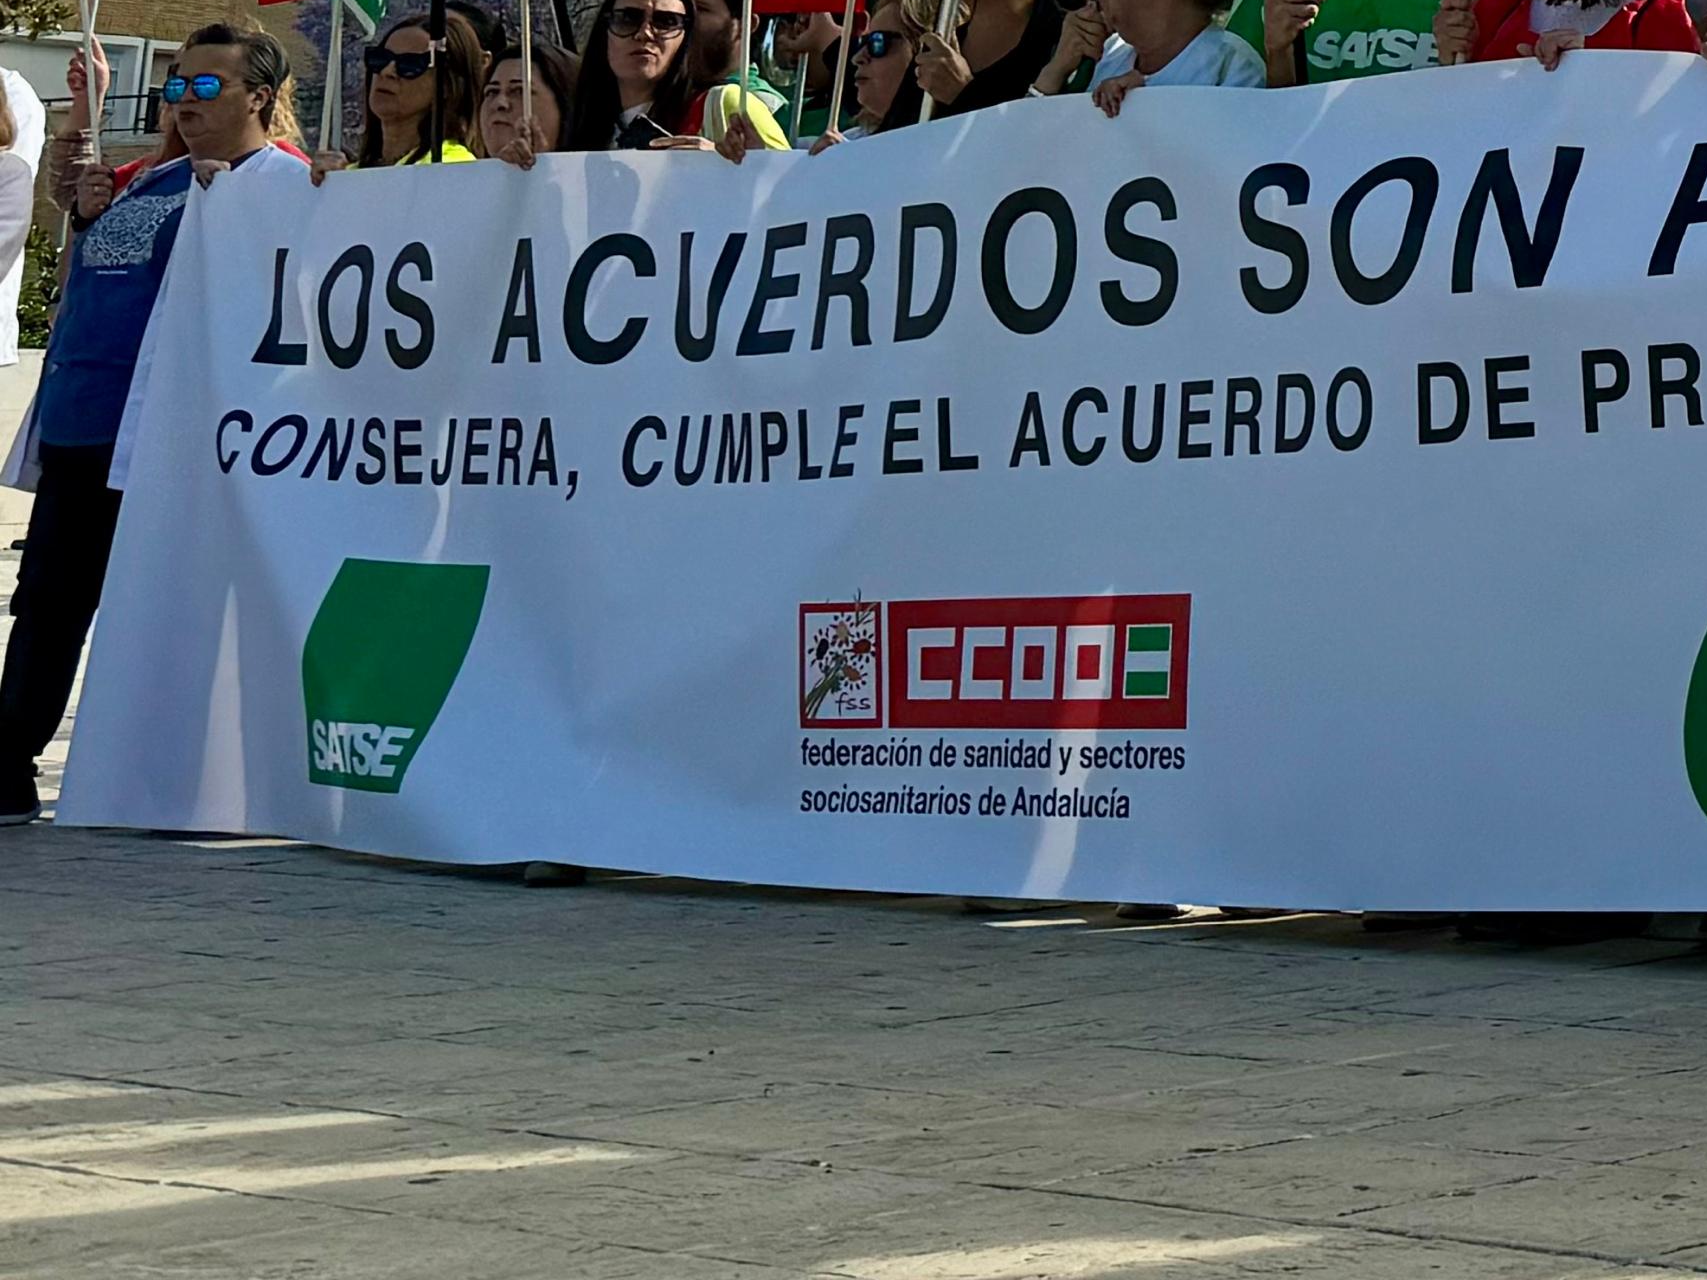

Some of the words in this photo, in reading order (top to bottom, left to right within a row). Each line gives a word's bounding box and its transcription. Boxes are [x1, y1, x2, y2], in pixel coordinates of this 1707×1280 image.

[1306, 29, 1440, 69] SATSE
[251, 242, 436, 370] LOS
[491, 175, 1180, 370] ACUERDOS
[1238, 144, 1586, 315] SON
[214, 409, 580, 501] CONSEJERA,
[620, 403, 865, 488] CUMPLE
[882, 396, 980, 475] EL
[1008, 366, 1374, 470] ACUERDO
[1418, 355, 1536, 445] DE
[906, 623, 1116, 701] CCOO
[834, 692, 872, 717] fss
[312, 718, 416, 778] SATSE
[800, 737, 923, 768] federación
[928, 738, 957, 768] de
[962, 738, 1052, 770] sanidad
[1057, 746, 1073, 776] y
[1079, 741, 1186, 771] sectores
[800, 784, 972, 816] sociosanitarios
[978, 786, 1007, 817] de
[1011, 785, 1131, 819] Andalucía
